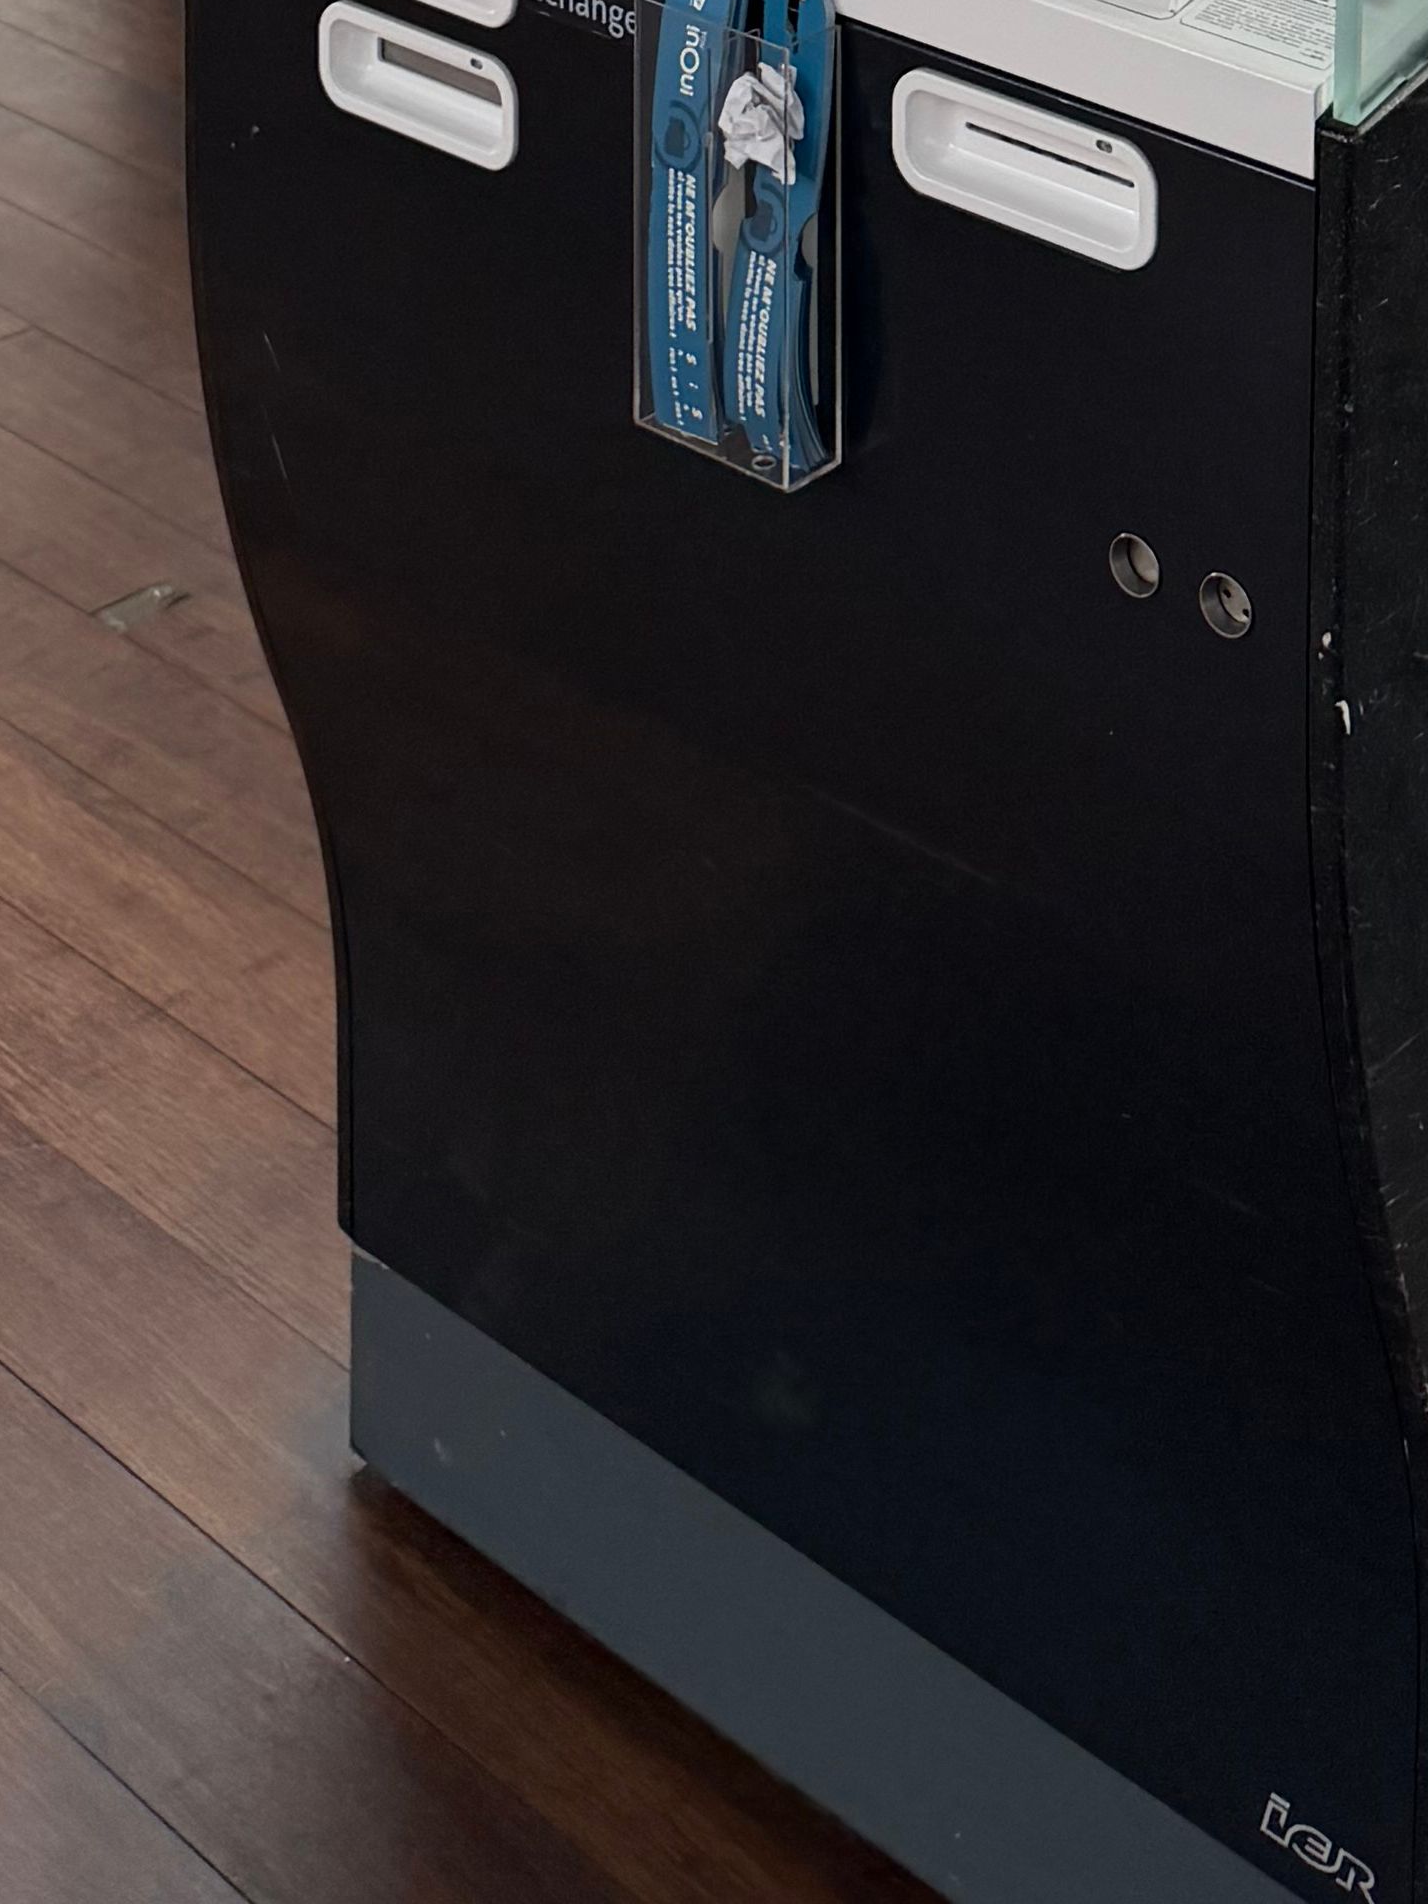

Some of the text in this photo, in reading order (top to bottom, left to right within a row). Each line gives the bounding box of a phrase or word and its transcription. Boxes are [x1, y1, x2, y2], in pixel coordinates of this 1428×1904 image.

[680, 24, 700, 97] inOui
[685, 174, 696, 331] NE M'OUBLIEZ PAS
[754, 258, 777, 418] NE M'OUBLIEZ PAS
